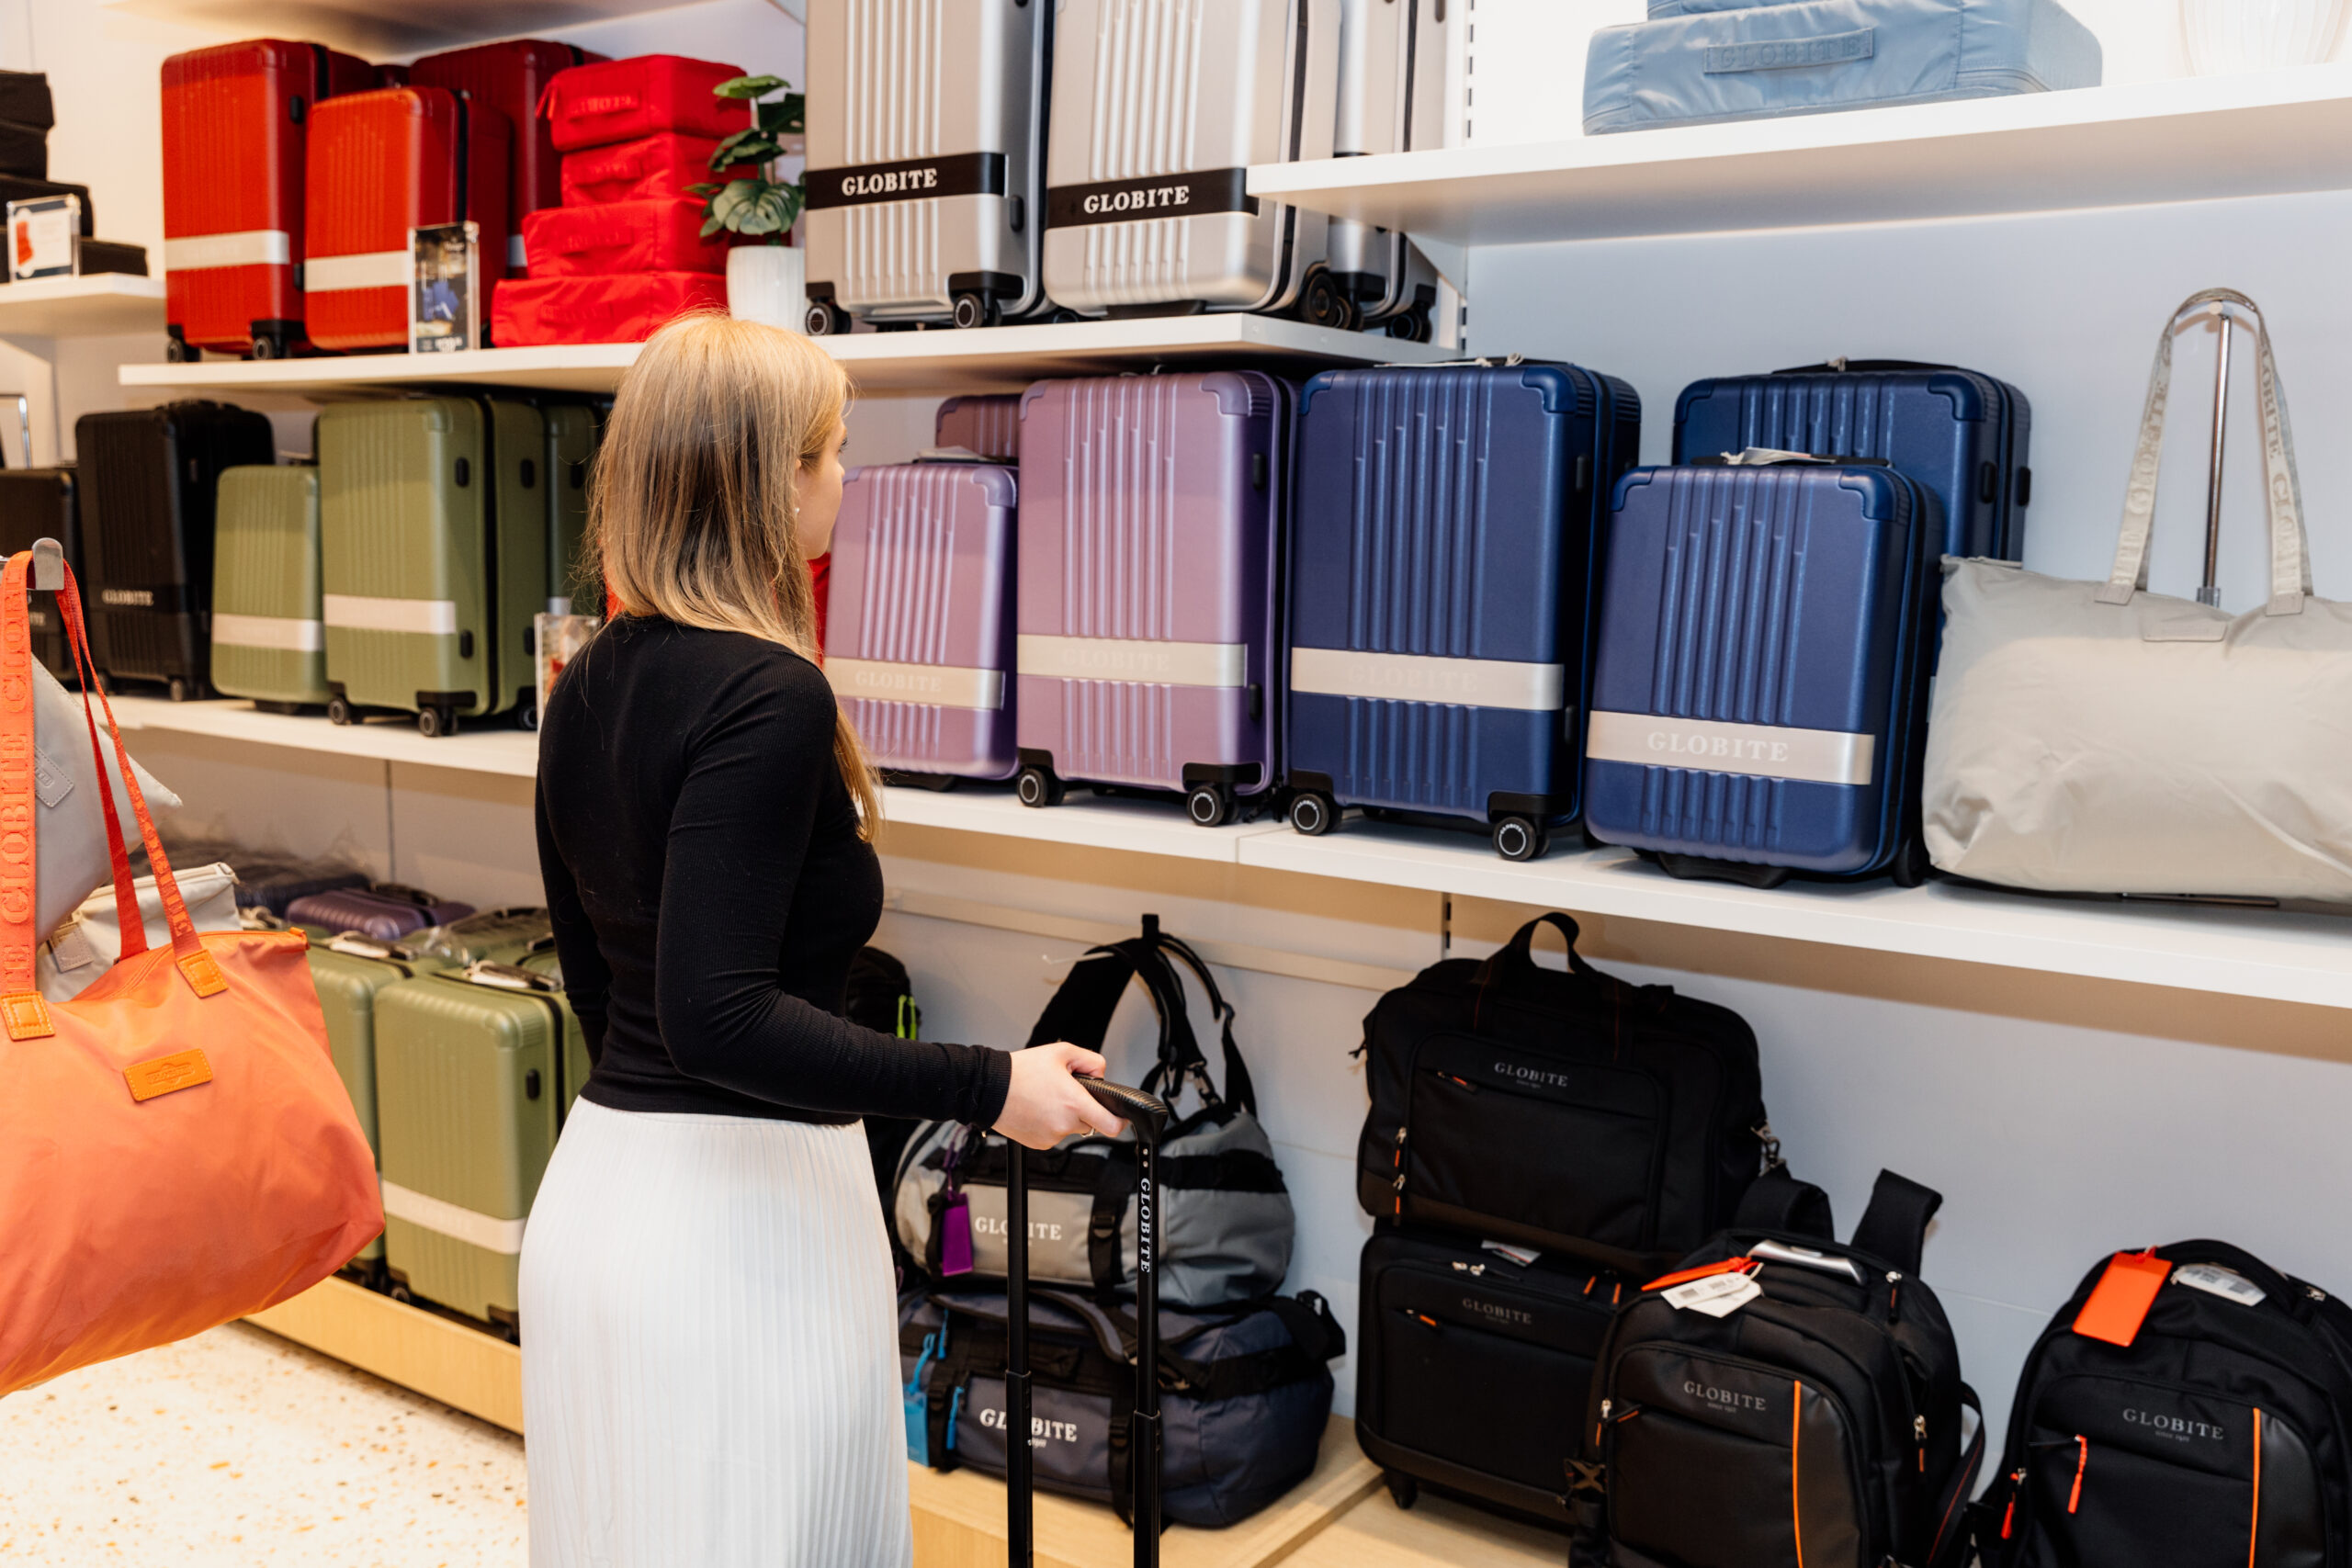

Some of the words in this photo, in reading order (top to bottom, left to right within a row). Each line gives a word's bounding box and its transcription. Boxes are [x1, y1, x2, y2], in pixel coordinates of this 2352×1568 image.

[1719, 38, 1862, 68] GLOBITE
[842, 168, 937, 197] GLOBITE
[1083, 186, 1190, 214] GLOBITE
[1062, 649, 1170, 672] GLOBITE
[855, 670, 942, 693] GLOBITE
[1348, 664, 1478, 693] GLOBITE
[1646, 731, 1789, 762] GLOBITE
[1, 734, 29, 923] GLOBITE
[1494, 1062, 1568, 1088] GLOBITE
[975, 1216, 1062, 1240] GLOITE
[1140, 1178, 1150, 1273] GLOBITE
[1462, 1297, 1532, 1325] GLOBITE
[1683, 1381, 1767, 1411] GLOBITE
[979, 1408, 1078, 1442] GLBITE
[2122, 1408, 2224, 1440] GLOBITE
